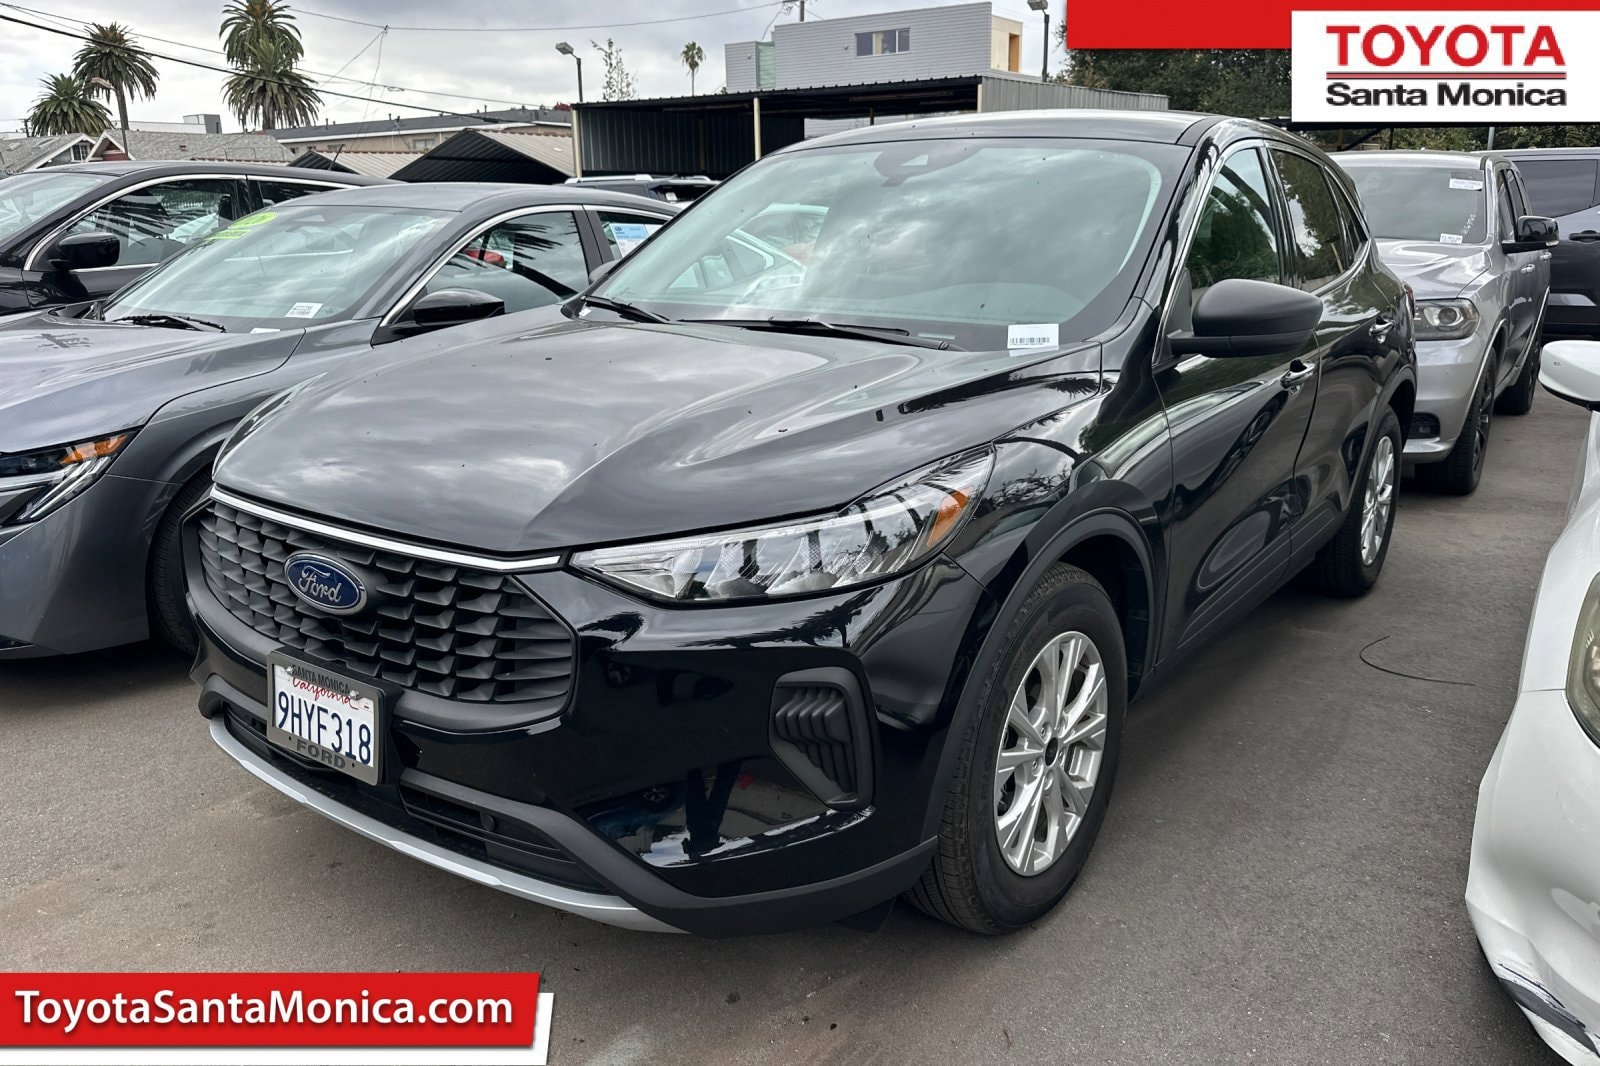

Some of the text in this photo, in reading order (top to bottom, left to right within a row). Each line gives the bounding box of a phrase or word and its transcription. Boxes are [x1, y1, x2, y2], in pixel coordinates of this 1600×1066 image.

[298, 565, 342, 602] Ford
[292, 664, 351, 695] SANTA MONICA
[278, 690, 371, 765] 9HYF318
[296, 739, 346, 769] FORD
